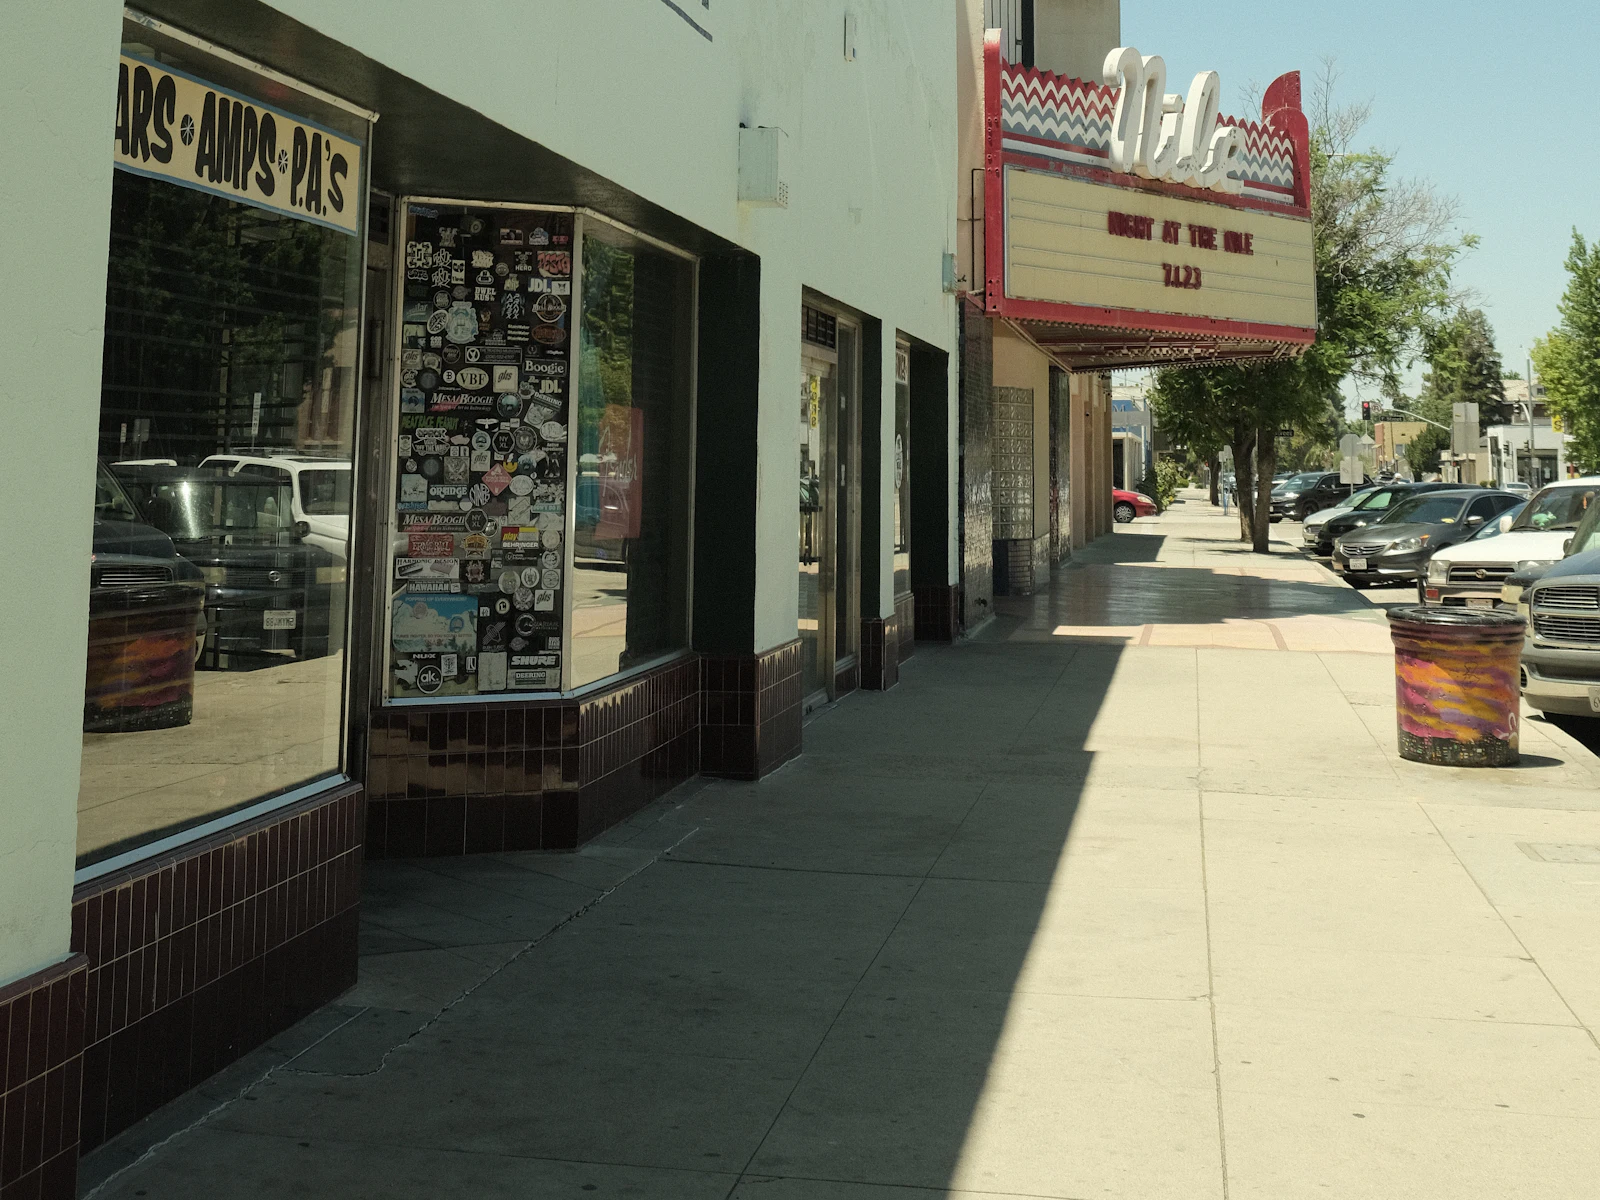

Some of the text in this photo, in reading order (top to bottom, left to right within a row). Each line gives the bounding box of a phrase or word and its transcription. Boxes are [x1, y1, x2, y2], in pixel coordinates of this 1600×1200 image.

[194, 90, 277, 197] AMPS
[1107, 210, 1254, 256] NIGHT AT THE NILE
[525, 360, 564, 375] Boogie
[460, 373, 486, 385] VBF
[429, 486, 468, 498] ORANGE
[409, 583, 449, 591] HAWAIIAN
[510, 655, 556, 666] SHURE
[515, 671, 546, 679] DEERING
